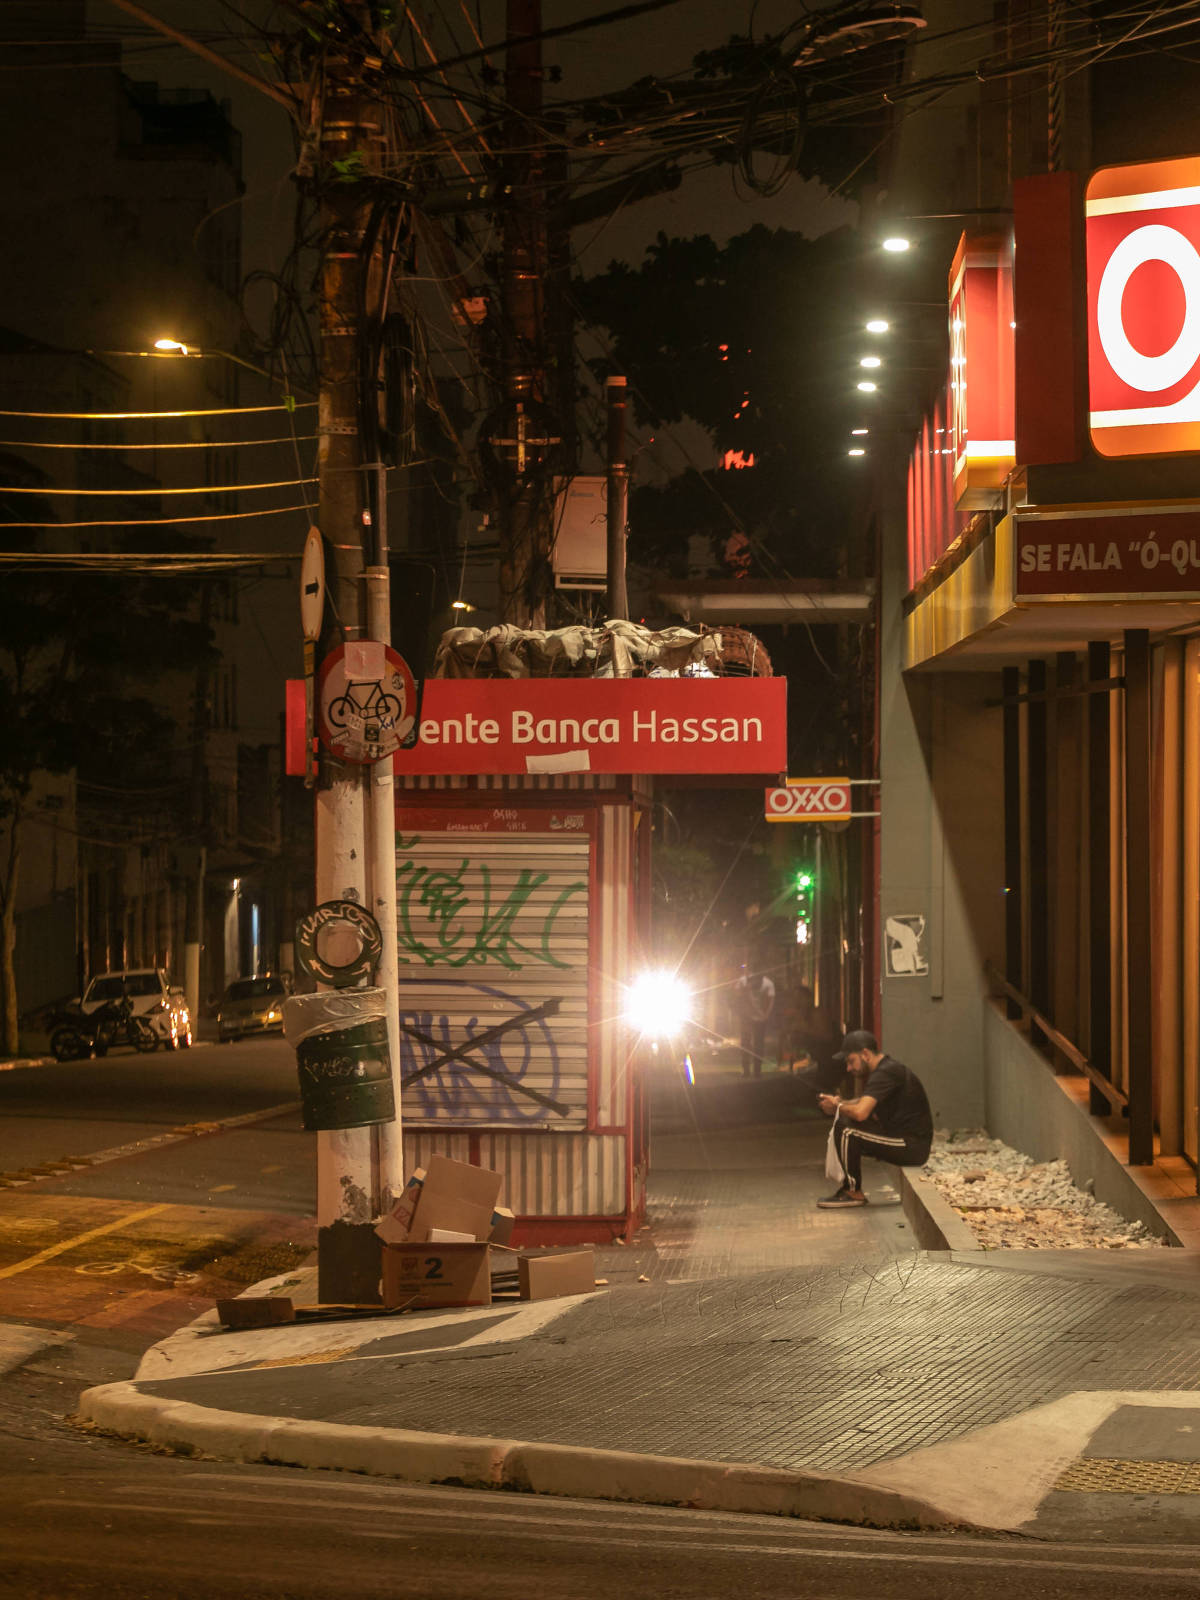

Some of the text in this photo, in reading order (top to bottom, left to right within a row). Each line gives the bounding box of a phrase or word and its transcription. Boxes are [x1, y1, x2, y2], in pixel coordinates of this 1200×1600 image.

[1020, 544, 1051, 572] SE
[1057, 542, 1122, 571] FALA
[419, 712, 500, 744] ente
[512, 710, 620, 744] Banca
[633, 710, 763, 743] Hassan
[769, 786, 847, 815] OXXO
[424, 1257, 443, 1279] 2
